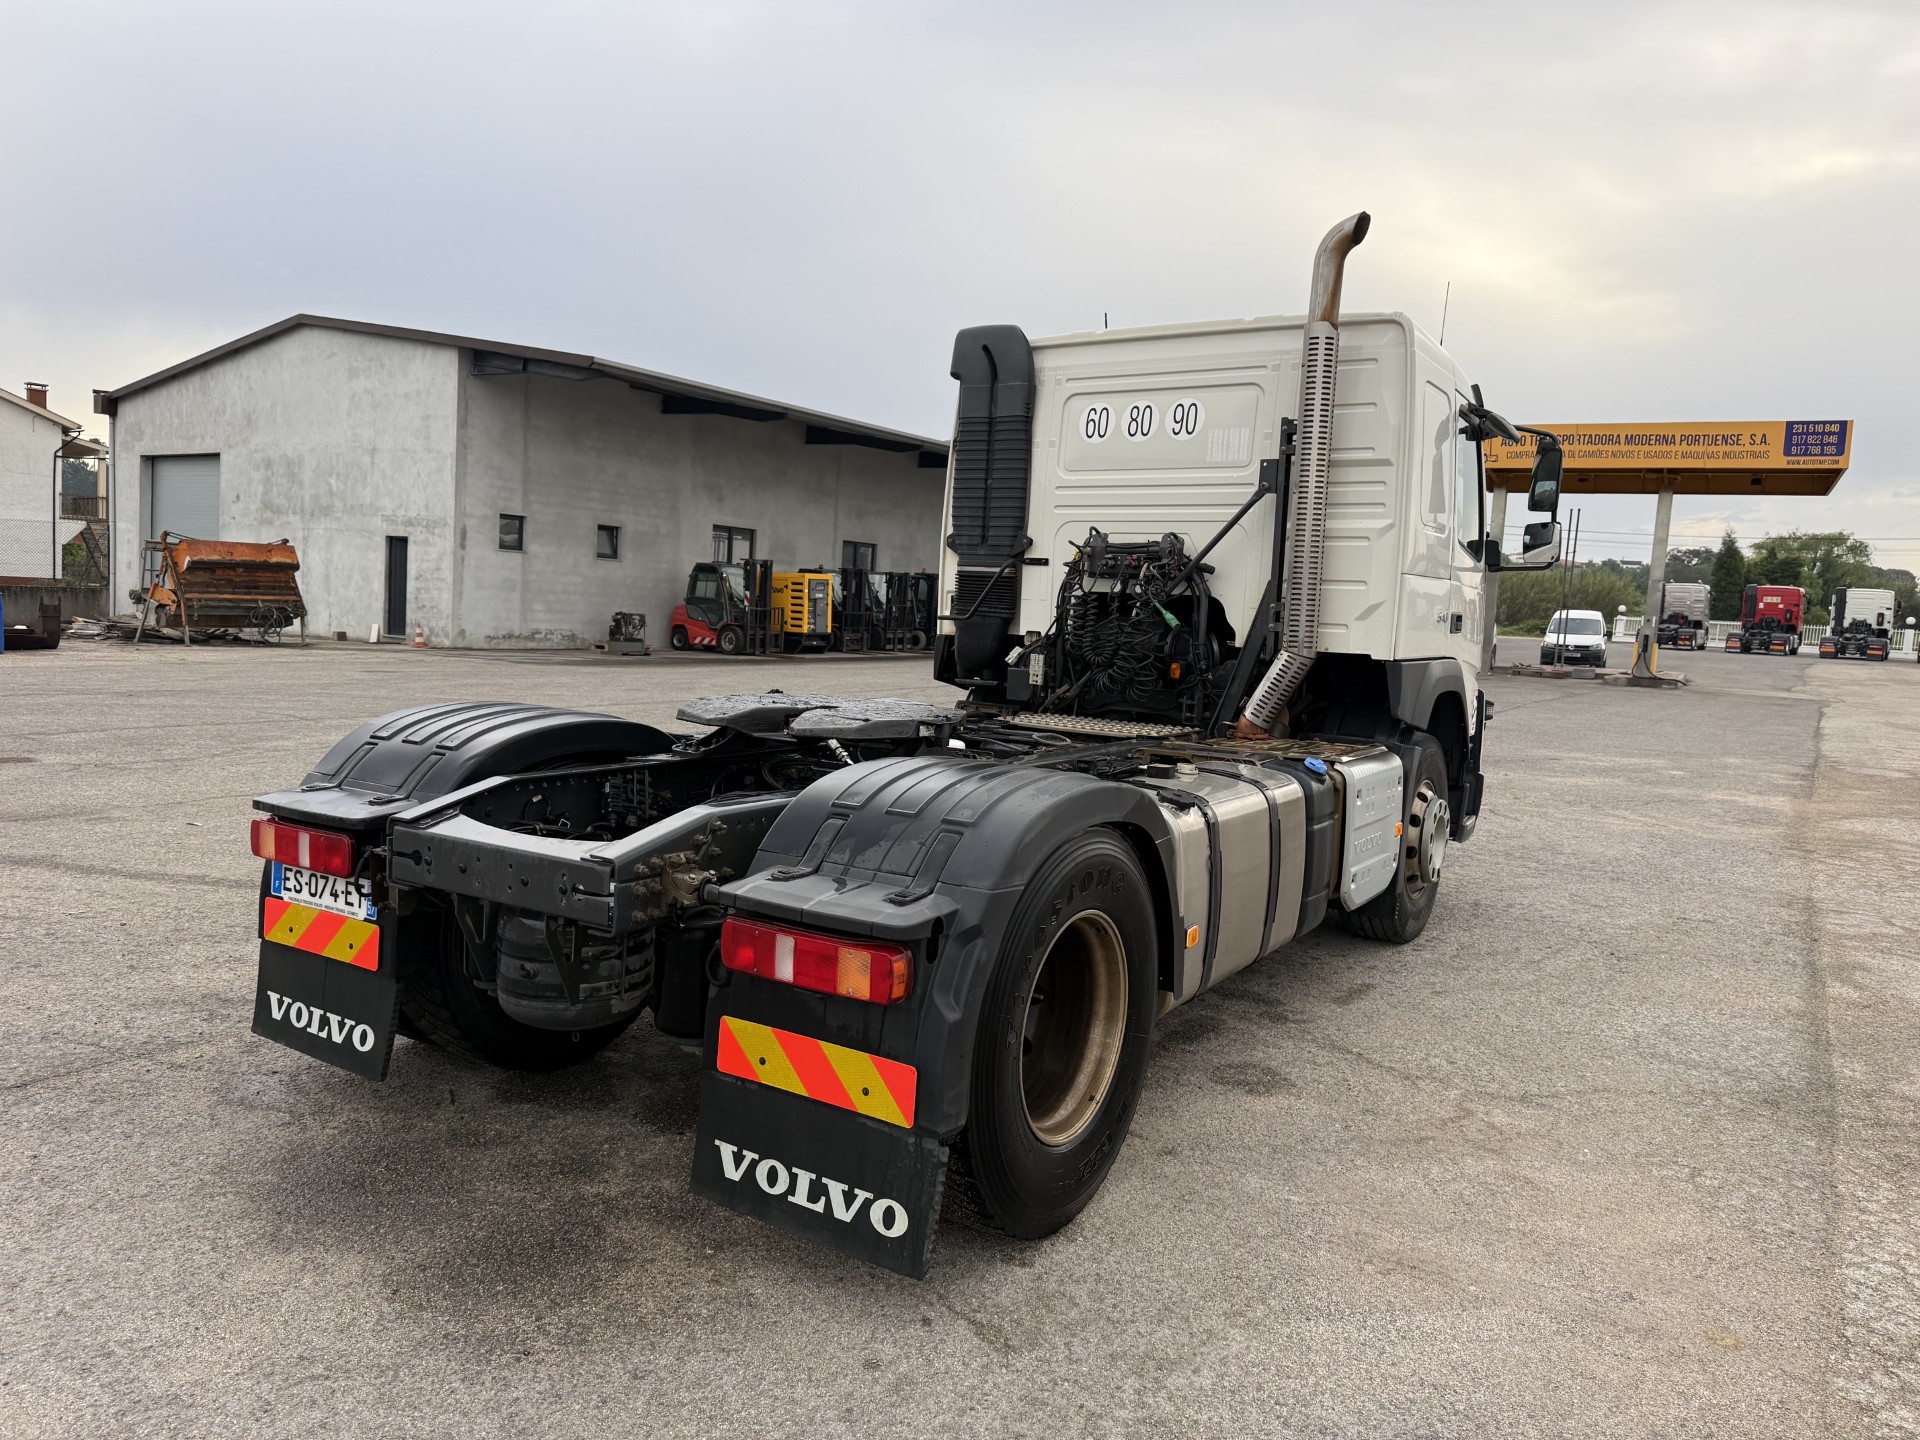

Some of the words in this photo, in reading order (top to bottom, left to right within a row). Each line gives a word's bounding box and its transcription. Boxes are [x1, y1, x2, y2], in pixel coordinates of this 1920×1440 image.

[1085, 407, 1109, 439] 60
[1127, 404, 1153, 437] 80
[1172, 402, 1198, 436] 90
[1793, 424, 1807, 432] 231
[1825, 423, 1840, 432] 840
[1624, 434, 1676, 446] MODERNA
[1679, 433, 1745, 447] PORTUENSE,
[1749, 433, 1771, 446] S.A.
[1791, 446, 1805, 454] 917
[1823, 446, 1836, 454] 195
[1792, 435, 1806, 444] 917
[1807, 435, 1821, 444] 822
[1823, 435, 1838, 443] 846
[1506, 450, 1535, 460] COMPRA
[1577, 448, 1609, 459] CAMIÕES
[1611, 450, 1636, 459] NOVOS
[1636, 450, 1641, 459] E
[1643, 450, 1673, 460] USADOS
[1674, 450, 1679, 459] E
[1680, 449, 1720, 460] MÁQUINAS
[1722, 450, 1770, 460] INDUSTRIAIS
[1353, 831, 1383, 855] VOLVO
[267, 990, 375, 1052] VOLVO
[714, 1138, 909, 1238] VOLVO
